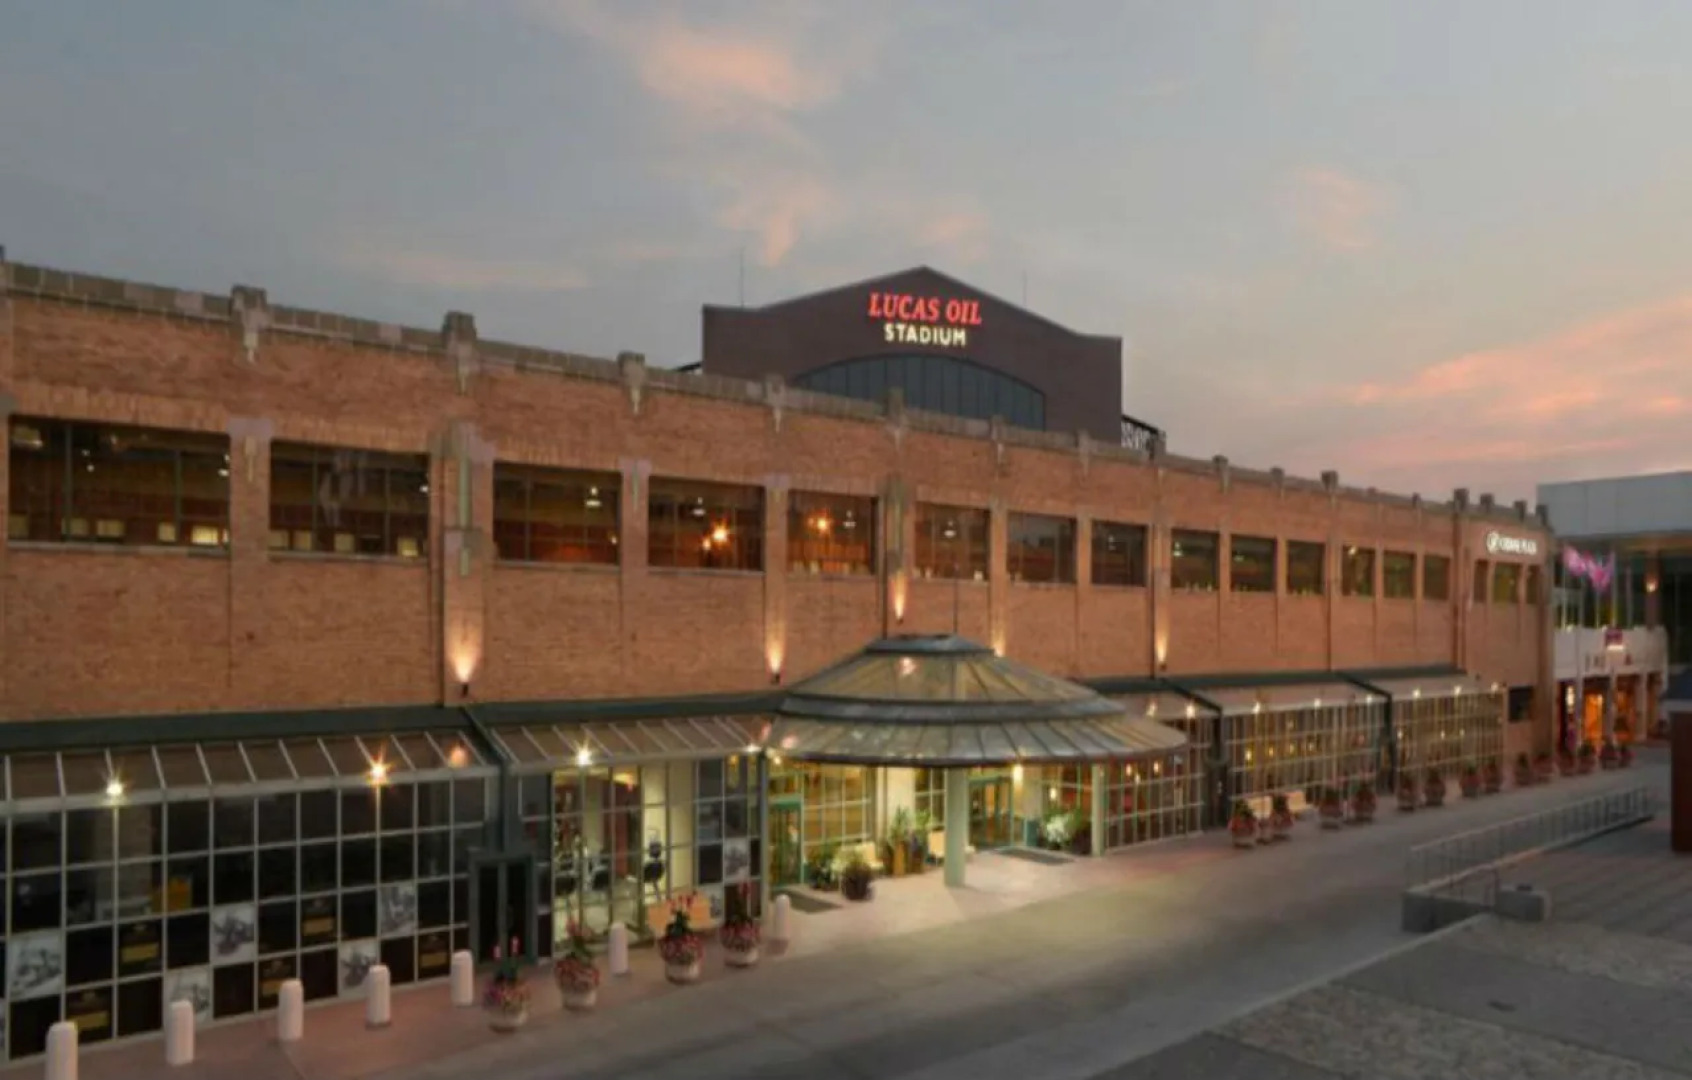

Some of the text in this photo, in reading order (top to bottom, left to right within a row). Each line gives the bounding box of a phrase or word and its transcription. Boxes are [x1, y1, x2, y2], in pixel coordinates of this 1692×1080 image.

[868, 292, 982, 325] LUCAS OIL
[884, 323, 967, 347] STADIUM
